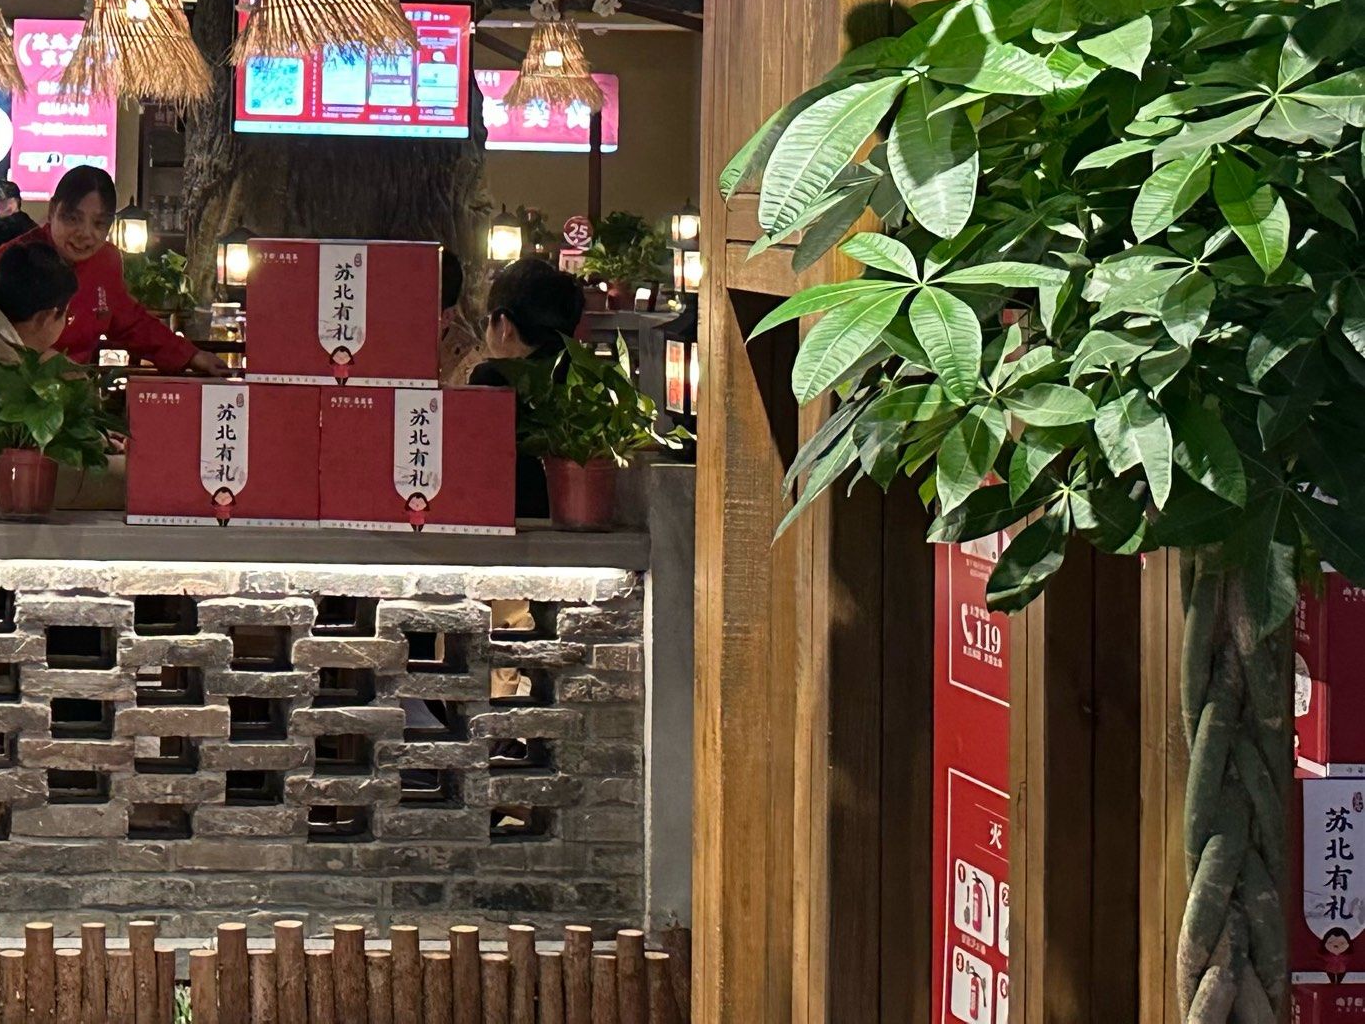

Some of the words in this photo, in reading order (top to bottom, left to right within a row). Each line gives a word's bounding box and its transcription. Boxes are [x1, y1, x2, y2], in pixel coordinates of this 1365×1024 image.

[569, 223, 589, 237] 25
[332, 262, 355, 342] 苏北有礼
[215, 403, 237, 483] 苏北有礼
[408, 407, 431, 488] 苏北有礼
[975, 620, 1001, 655] 119
[1323, 806, 1355, 921] 苏北有礼
